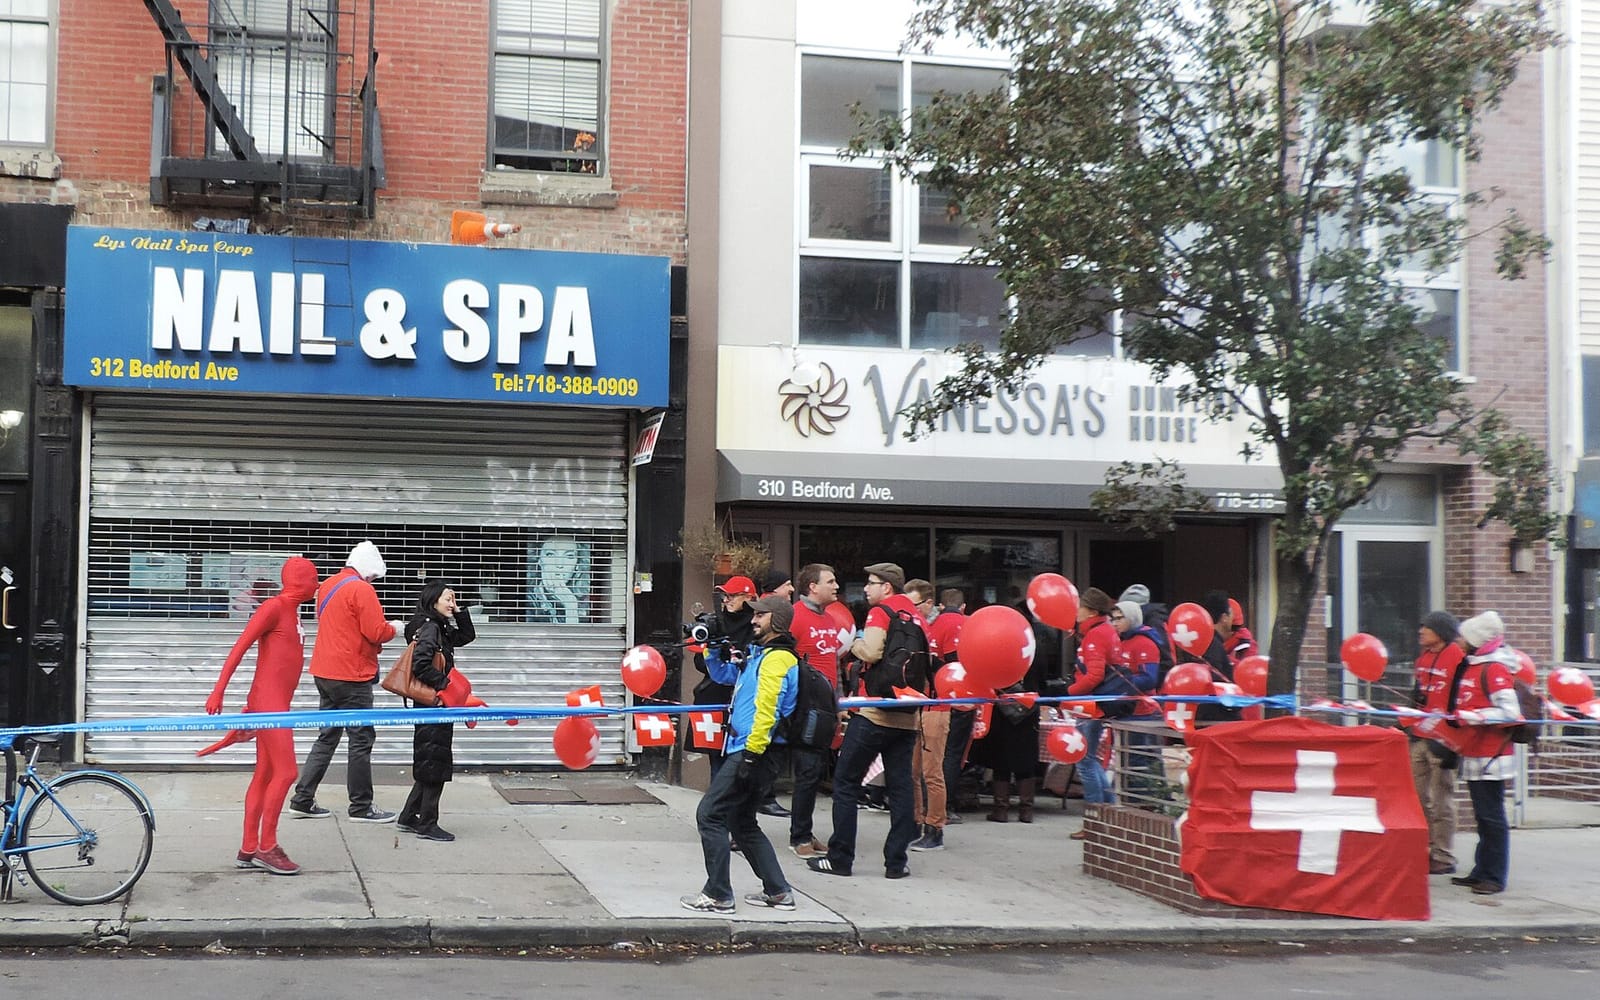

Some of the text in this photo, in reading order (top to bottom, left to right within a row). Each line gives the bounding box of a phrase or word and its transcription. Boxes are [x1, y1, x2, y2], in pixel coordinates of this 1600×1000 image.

[94, 235, 254, 256] Lys Nail Spa Corp
[151, 266, 598, 367] NAIL & SPA
[90, 357, 239, 381] 312 Bedford Ave
[1130, 415, 1197, 443] HOUSE
[758, 480, 894, 500] 310 Bedford Ave.
